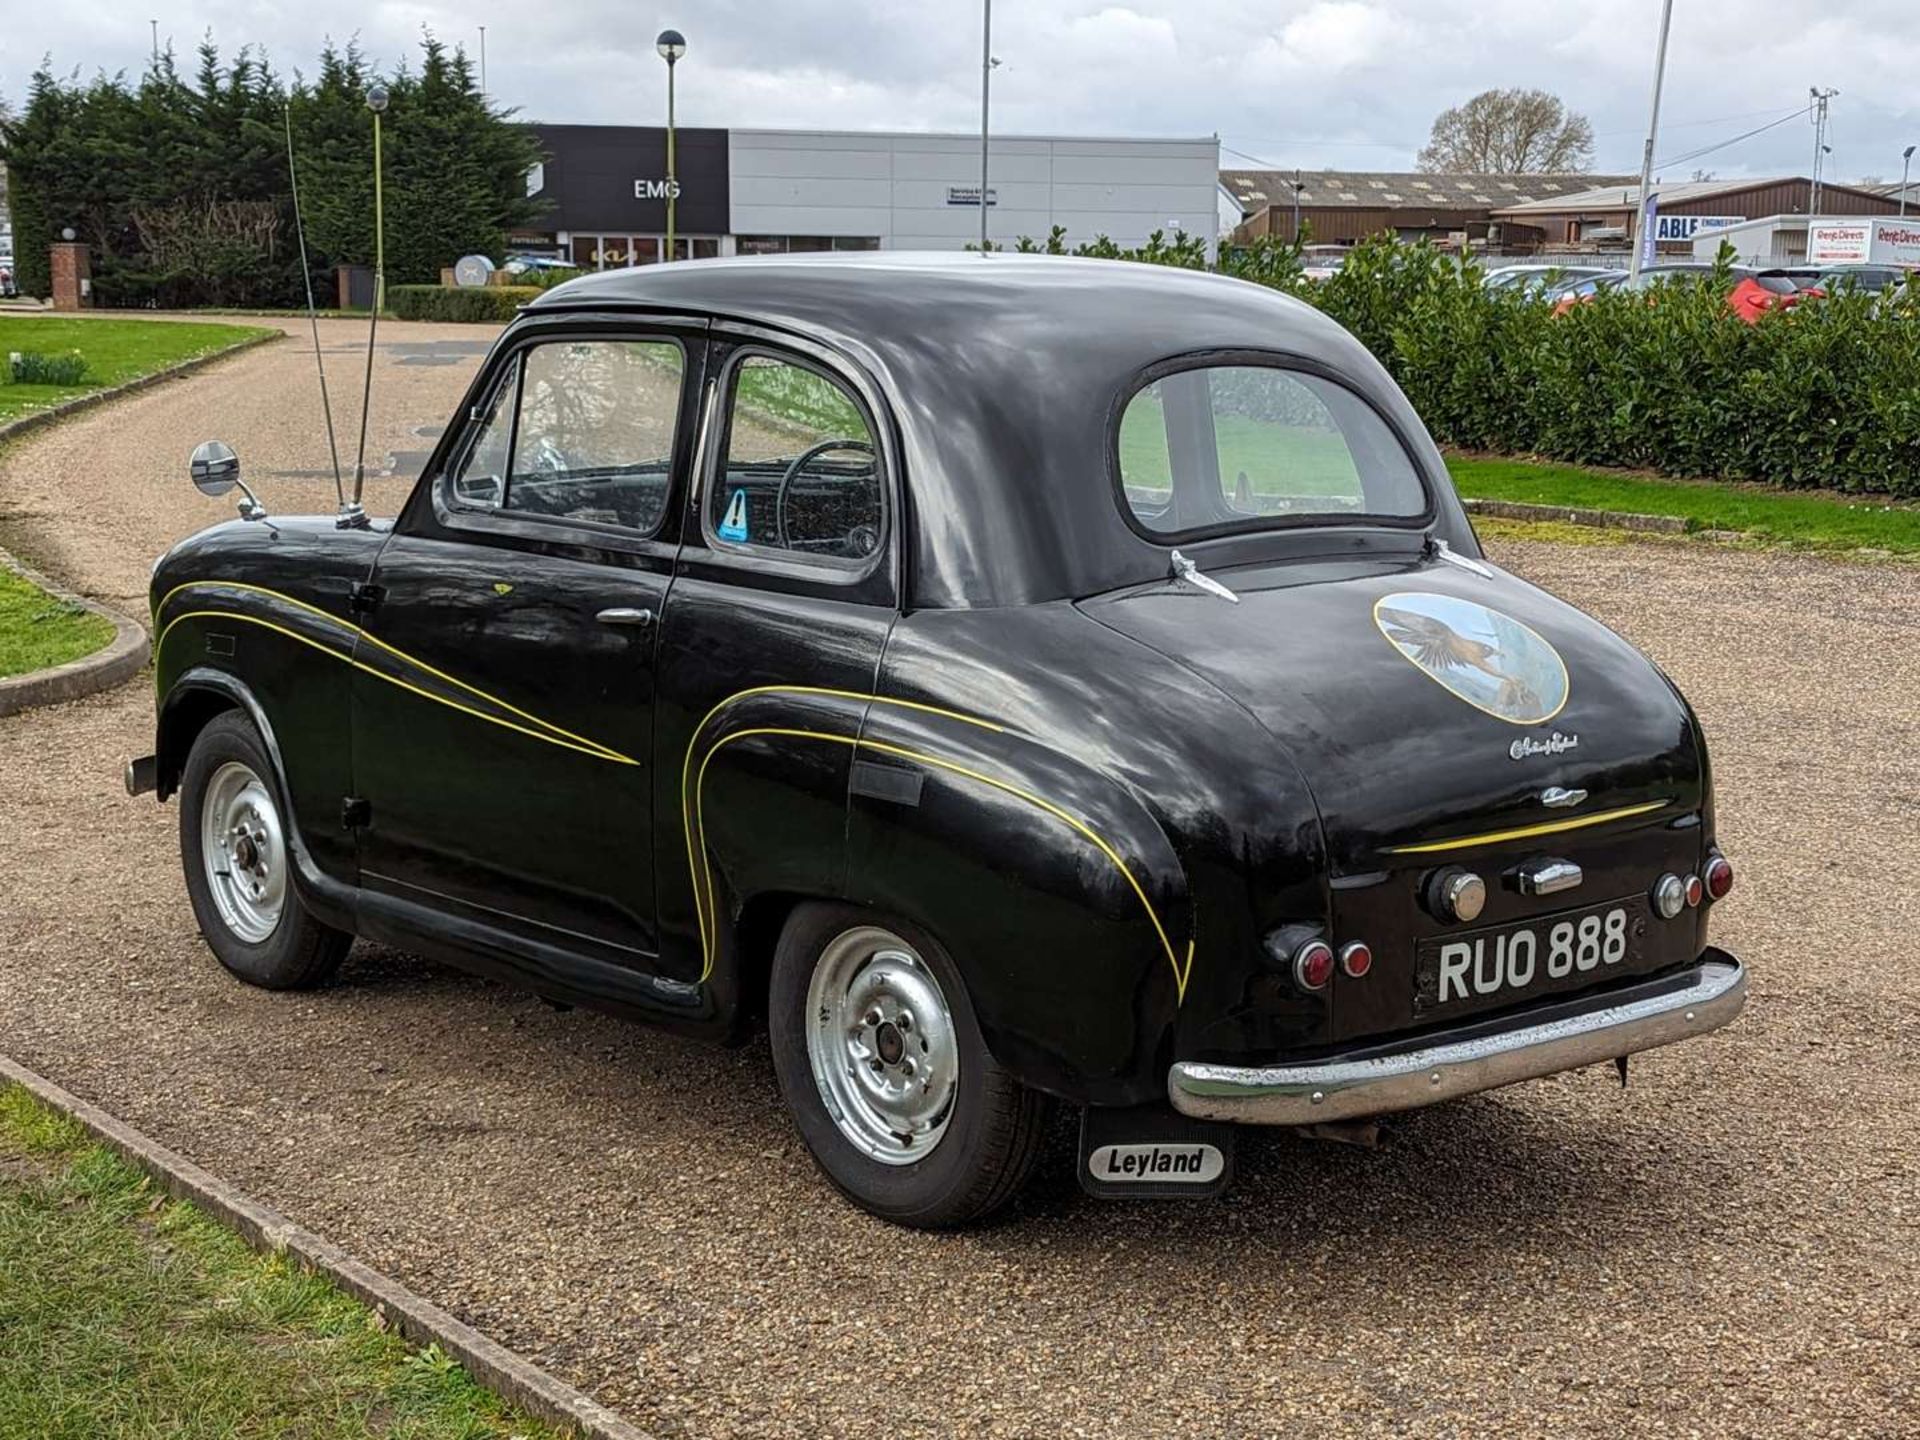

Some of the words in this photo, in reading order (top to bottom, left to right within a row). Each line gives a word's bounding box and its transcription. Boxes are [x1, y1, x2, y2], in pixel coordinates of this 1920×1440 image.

[635, 180, 680, 199] EMG
[1659, 218, 1698, 239] ABLE
[1900, 229, 1920, 244] Direc
[1439, 930, 1536, 1002] RUO
[1548, 908, 1627, 978] 888
[1108, 1148, 1204, 1177] Leyland
